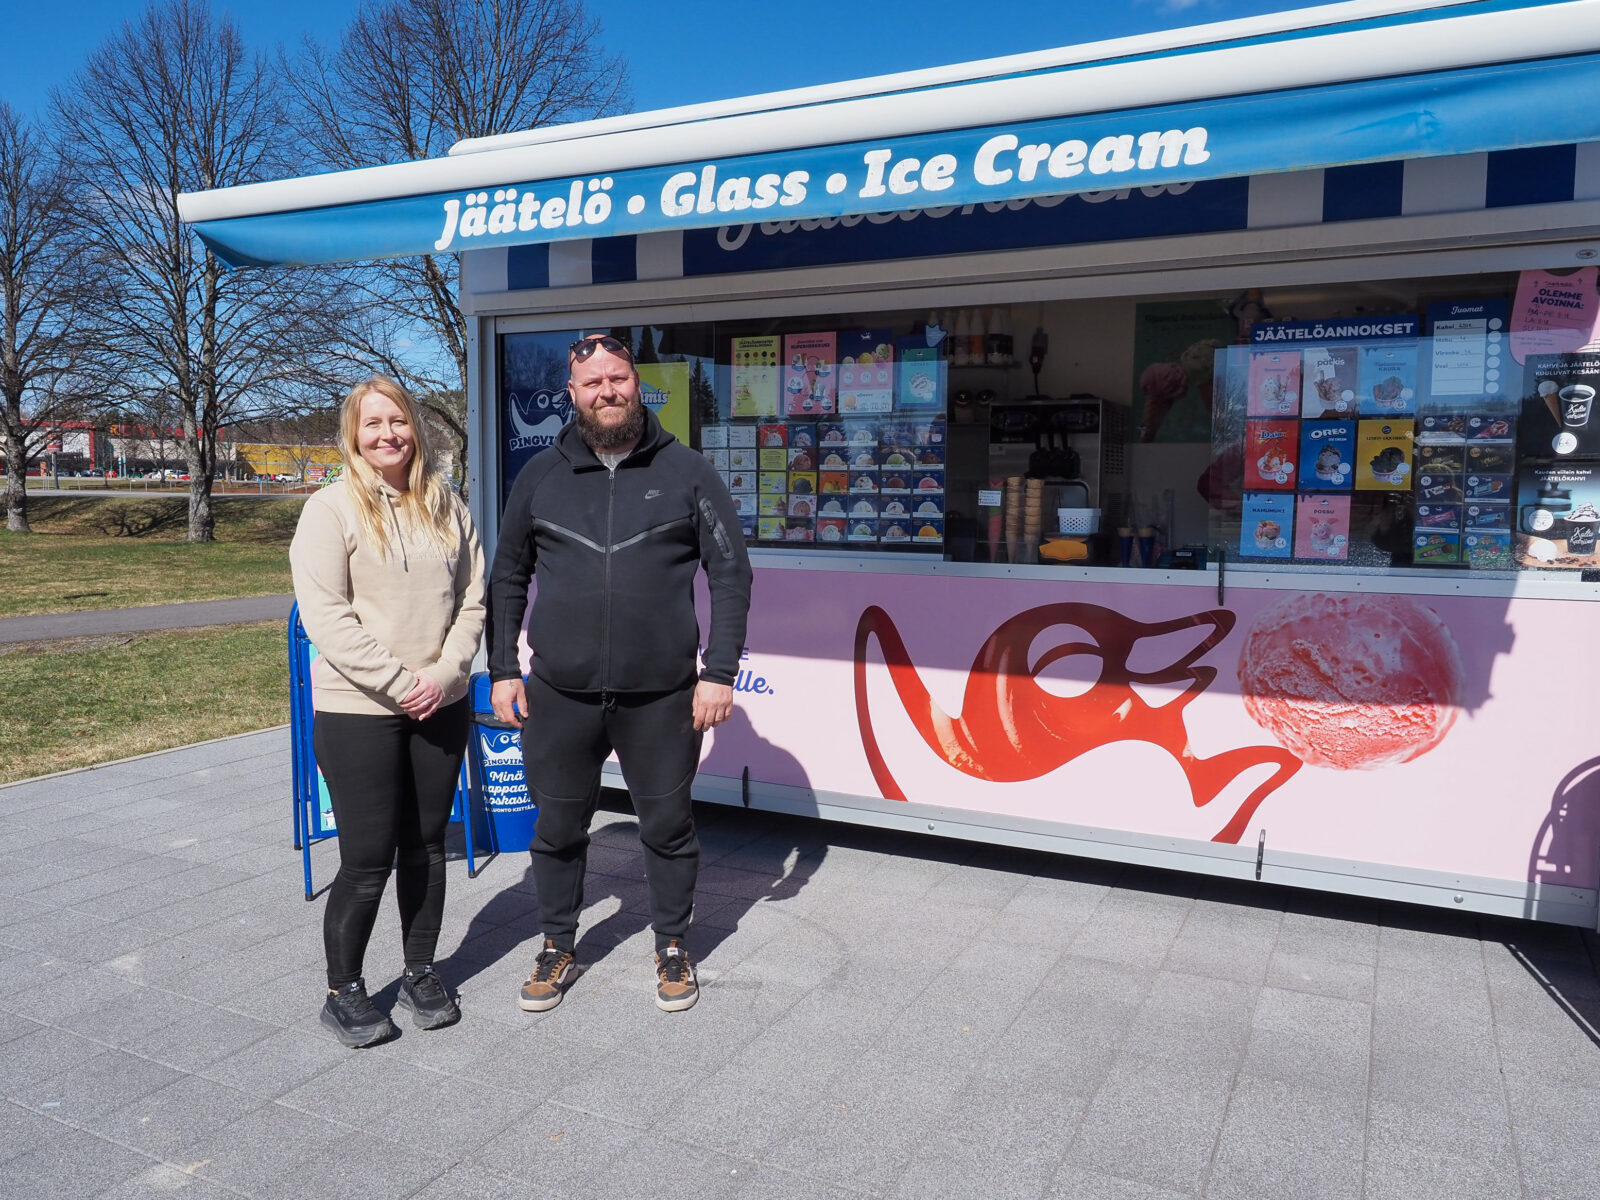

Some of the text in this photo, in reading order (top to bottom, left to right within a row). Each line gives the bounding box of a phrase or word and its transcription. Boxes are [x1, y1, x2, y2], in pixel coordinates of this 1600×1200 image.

[434, 127, 1211, 250] Jäätelö Glass Ice Cream
[1539, 288, 1583, 301] OLEMME
[1531, 296, 1584, 310] AVOINNA:
[1451, 306, 1485, 315] Juomat
[1255, 322, 1414, 342] JÄÄTELÖANNOKSET
[1310, 428, 1347, 439] OREO
[509, 434, 557, 451] PINGVI
[732, 670, 774, 695] lle.
[483, 758, 524, 767] PINGVIIN
[489, 770, 525, 783] Minä
[481, 784, 528, 796] nappaa
